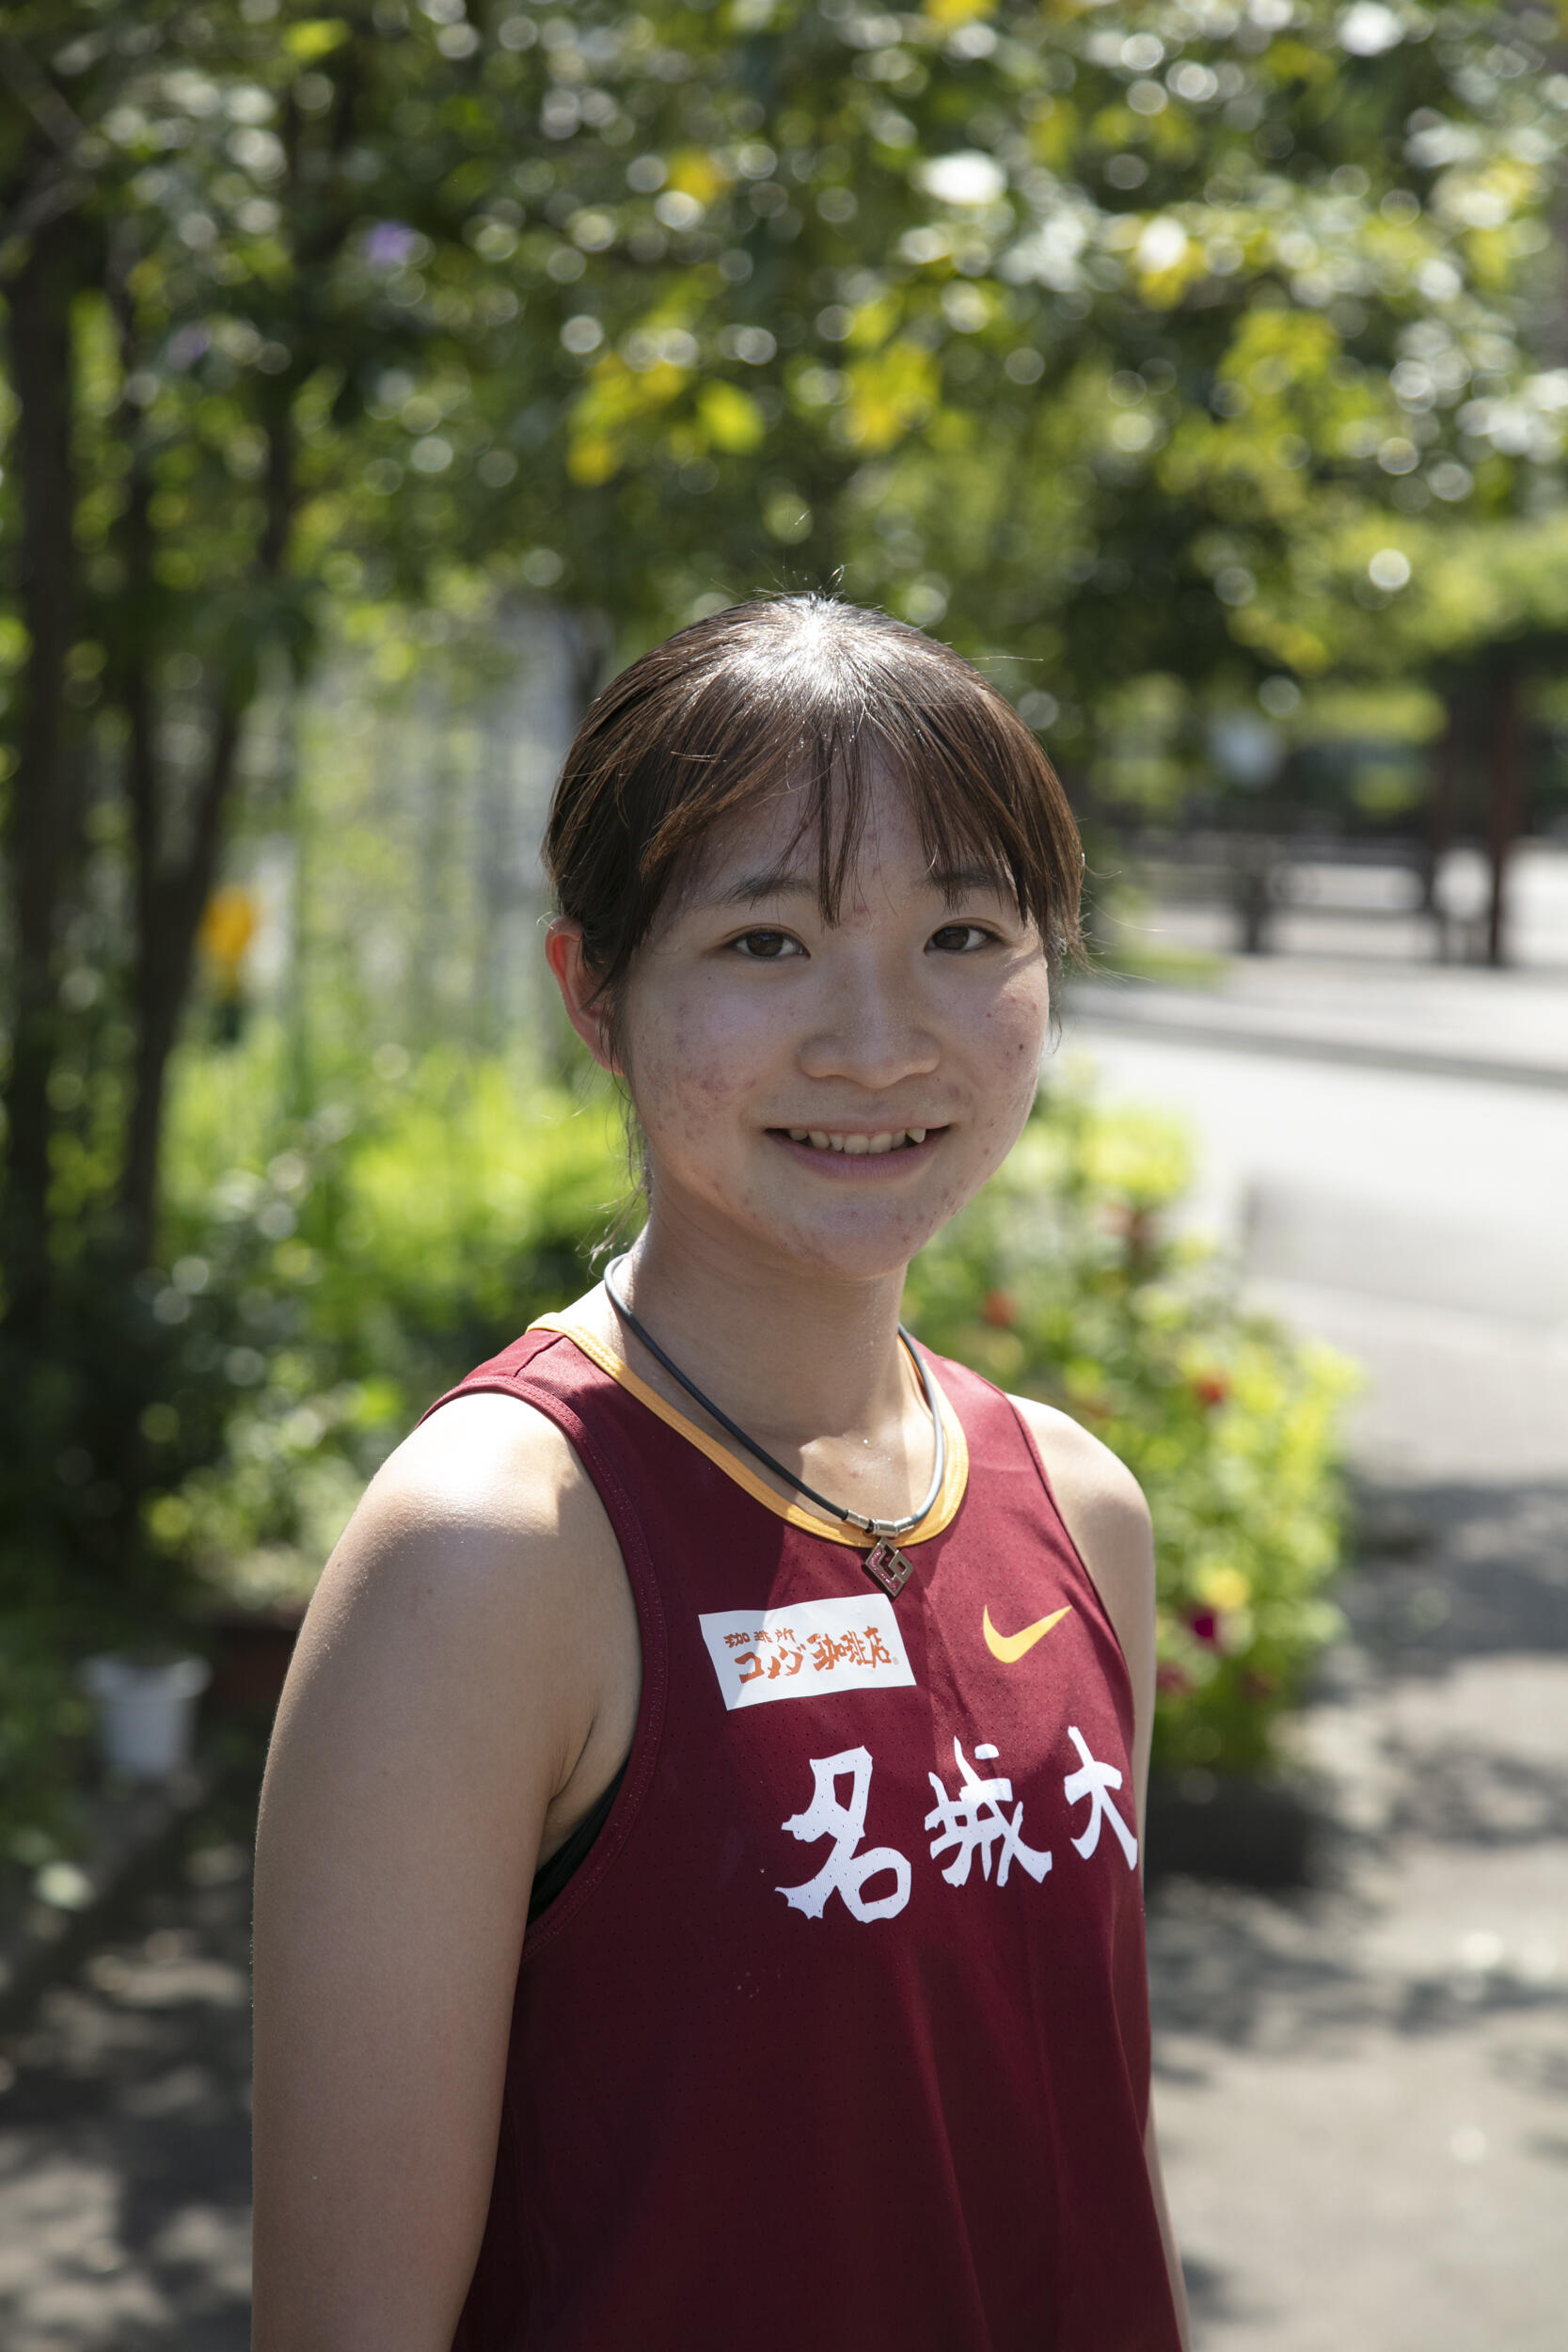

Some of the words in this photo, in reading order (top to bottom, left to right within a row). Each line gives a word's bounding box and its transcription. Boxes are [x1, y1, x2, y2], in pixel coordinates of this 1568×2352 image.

[735, 1626, 892, 1684] コメダ珈琲店
[774, 1725, 1138, 1924] 名城大
